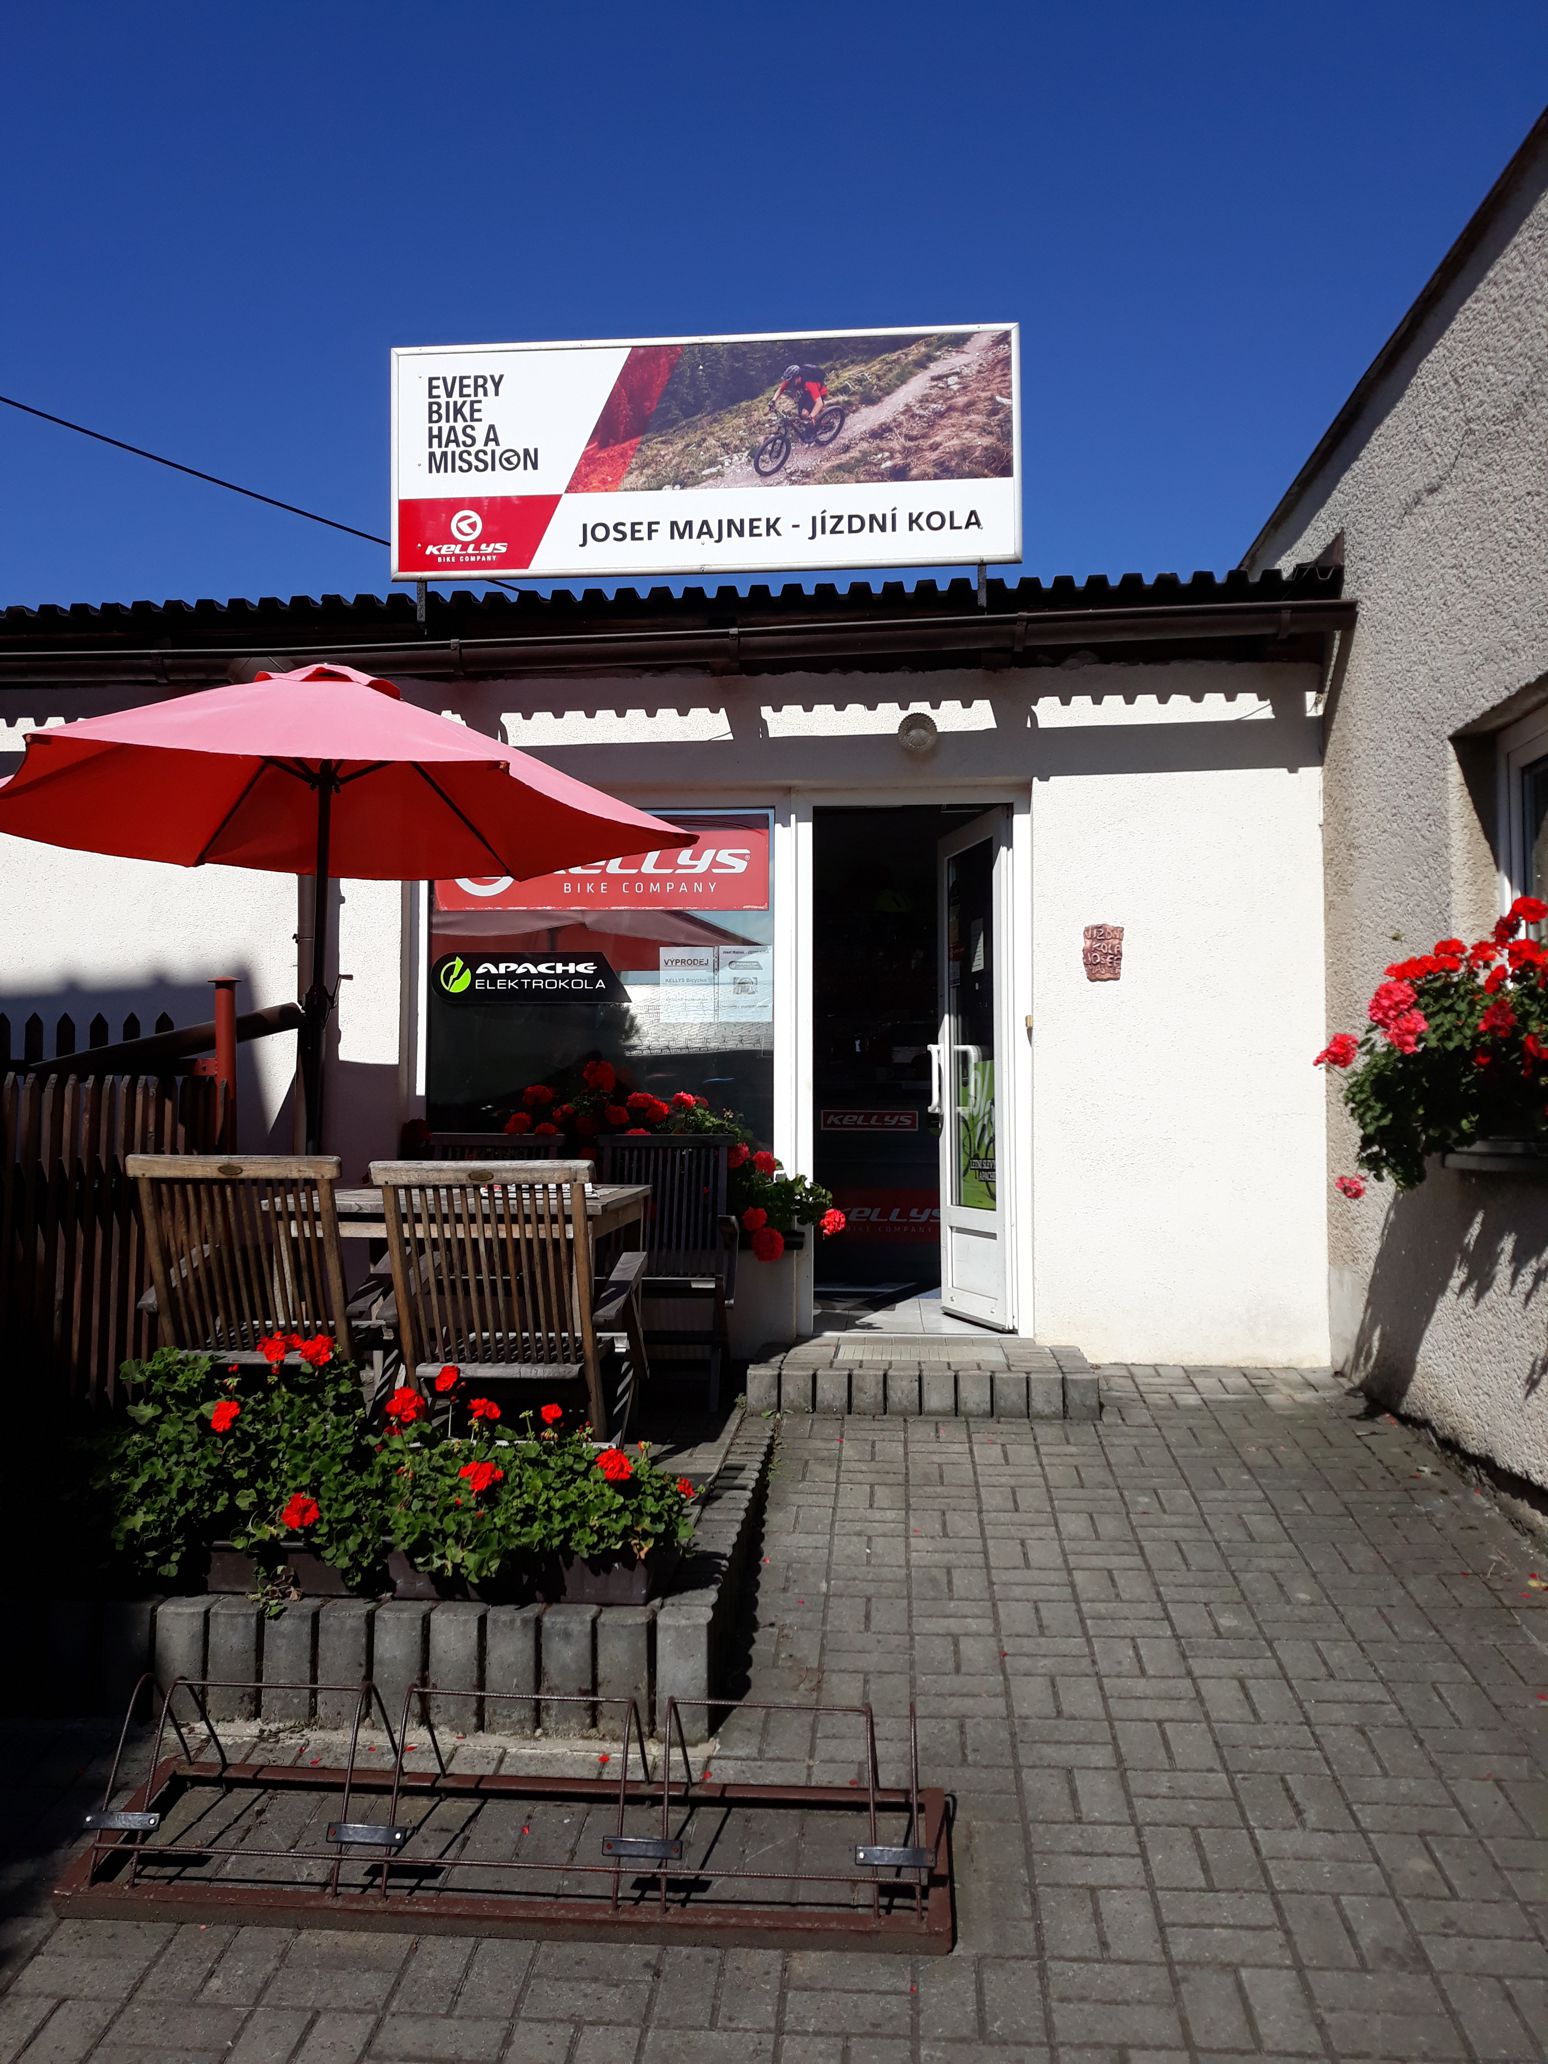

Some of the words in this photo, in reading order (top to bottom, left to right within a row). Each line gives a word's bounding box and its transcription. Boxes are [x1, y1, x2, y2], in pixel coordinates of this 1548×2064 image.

[427, 373, 505, 399] EVERY
[427, 400, 483, 424] BIKE
[427, 425, 477, 448] HAS
[484, 424, 500, 446] A
[427, 448, 539, 473] MISSION
[579, 520, 660, 547] JOSEF
[669, 517, 781, 543] MAJNEK
[808, 507, 897, 540] JÍZDNÍ
[907, 509, 982, 532] KOLA
[425, 542, 508, 555] KELLYS
[563, 882, 608, 894] BIKE
[622, 881, 718, 894] COMPANY
[475, 961, 598, 975] APACHE
[475, 978, 606, 990] ELEKTROKOLA
[827, 1113, 913, 1126] KELLYS
